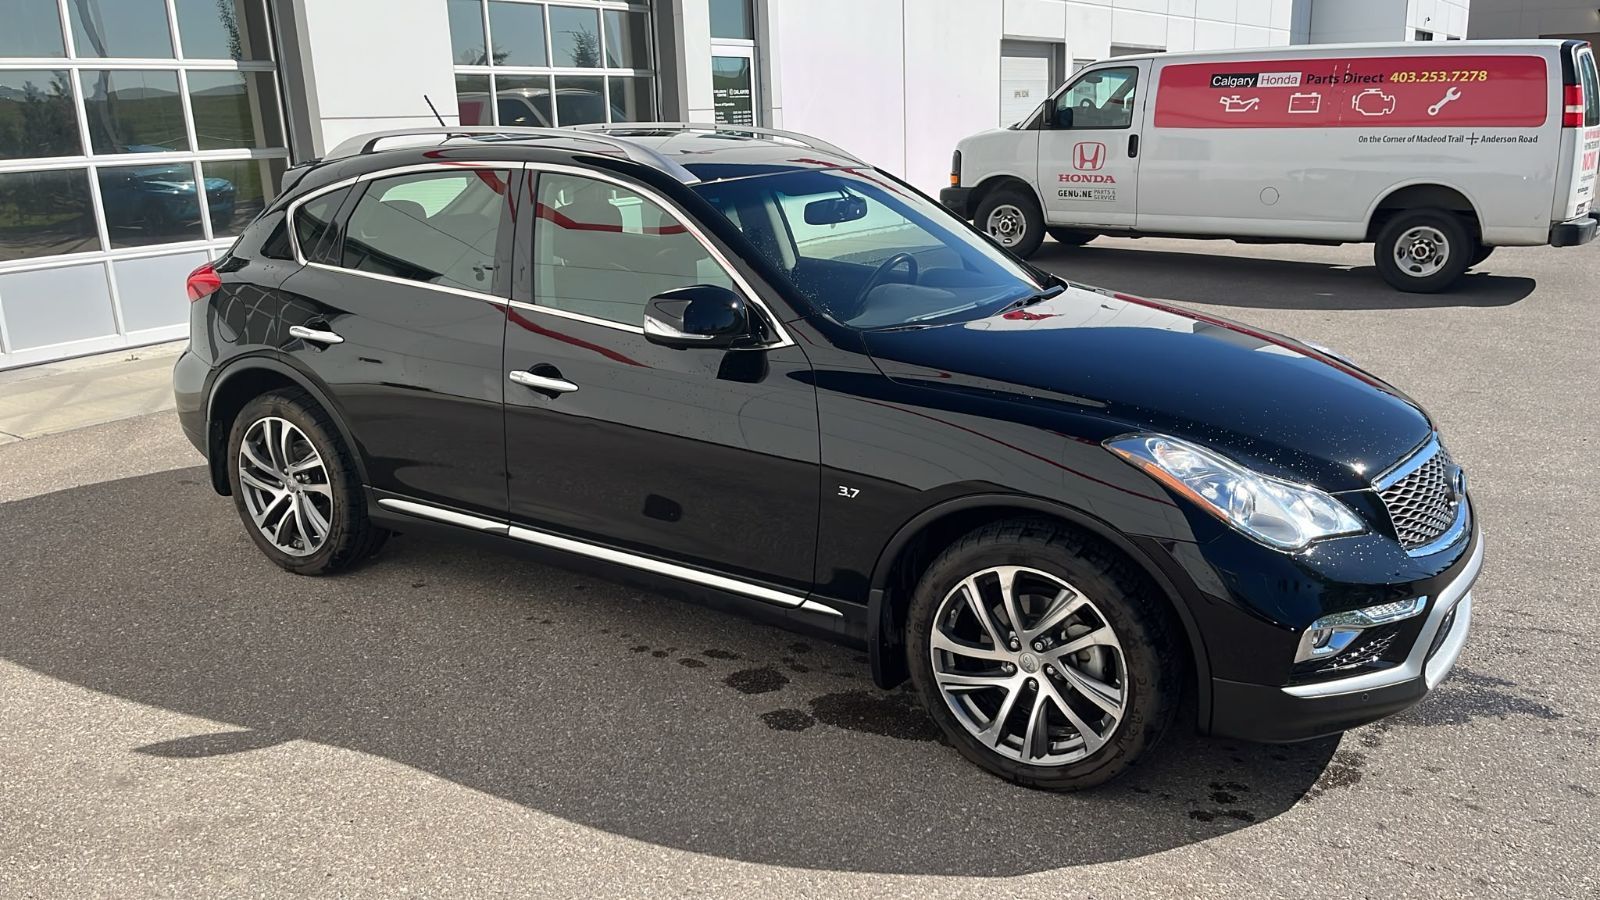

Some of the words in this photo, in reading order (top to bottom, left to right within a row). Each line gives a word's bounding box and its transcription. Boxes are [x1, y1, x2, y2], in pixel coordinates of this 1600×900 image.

[1212, 76, 1255, 88] Calgary
[1260, 75, 1297, 85] Honda
[1306, 75, 1340, 84] Parts
[1343, 72, 1384, 83] Direct
[1390, 71, 1488, 83] 403.253.7278
[1358, 135, 1369, 143] On
[1369, 135, 1382, 143] the
[1383, 135, 1406, 143] Corner
[1407, 135, 1416, 143] of
[1416, 135, 1447, 143] Macleod
[1448, 135, 1465, 143] Trail
[1480, 135, 1517, 143] Anderson
[1518, 135, 1539, 143] Road
[1058, 174, 1116, 183] HONDA
[837, 485, 860, 498] 3.7
